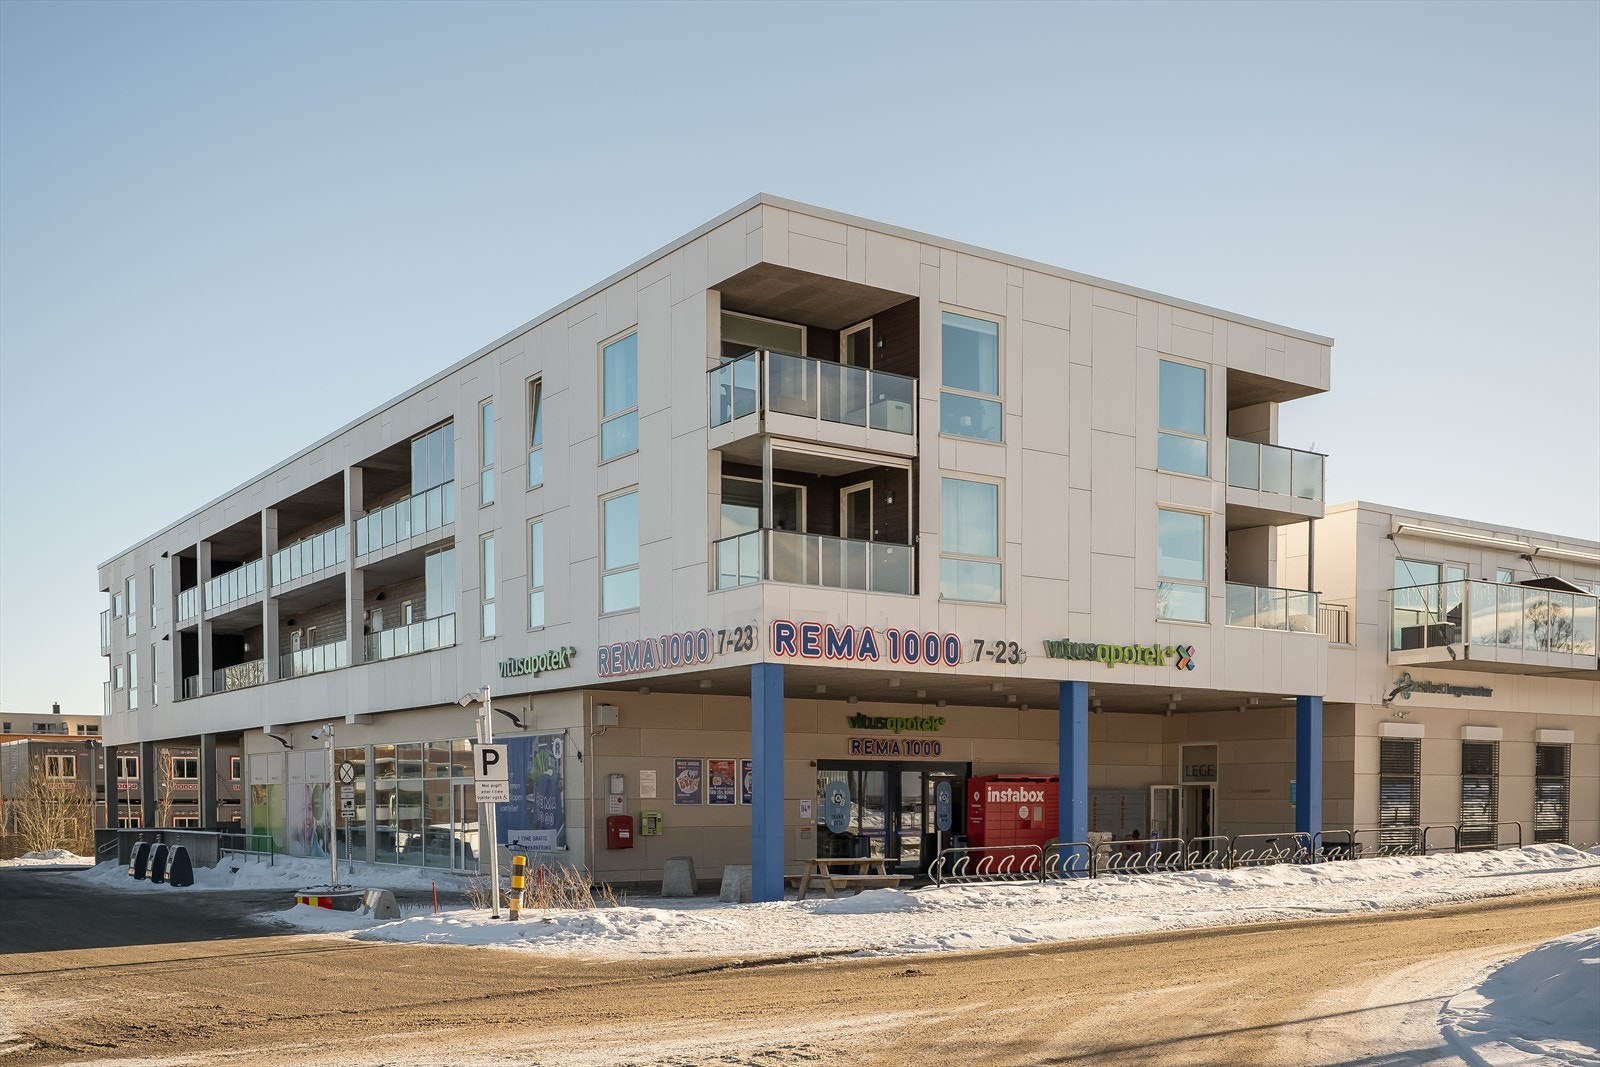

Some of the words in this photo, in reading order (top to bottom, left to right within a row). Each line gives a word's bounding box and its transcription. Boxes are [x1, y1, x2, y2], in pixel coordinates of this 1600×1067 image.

[598, 639, 656, 677] REMA
[660, 629, 712, 669] 1000
[718, 624, 754, 655] 7-23
[773, 620, 879, 662] REMA
[886, 628, 961, 667] 1000
[974, 639, 1019, 664] 7-23
[1043, 637, 1169, 668] vitusapotek
[499, 646, 571, 678] vitusapotek
[847, 712, 940, 734] vitusapotek
[850, 738, 901, 756] REMA
[903, 740, 942, 757] 1000
[482, 749, 499, 776] P
[1185, 764, 1215, 777] LEGE
[987, 786, 1045, 803] instabox
